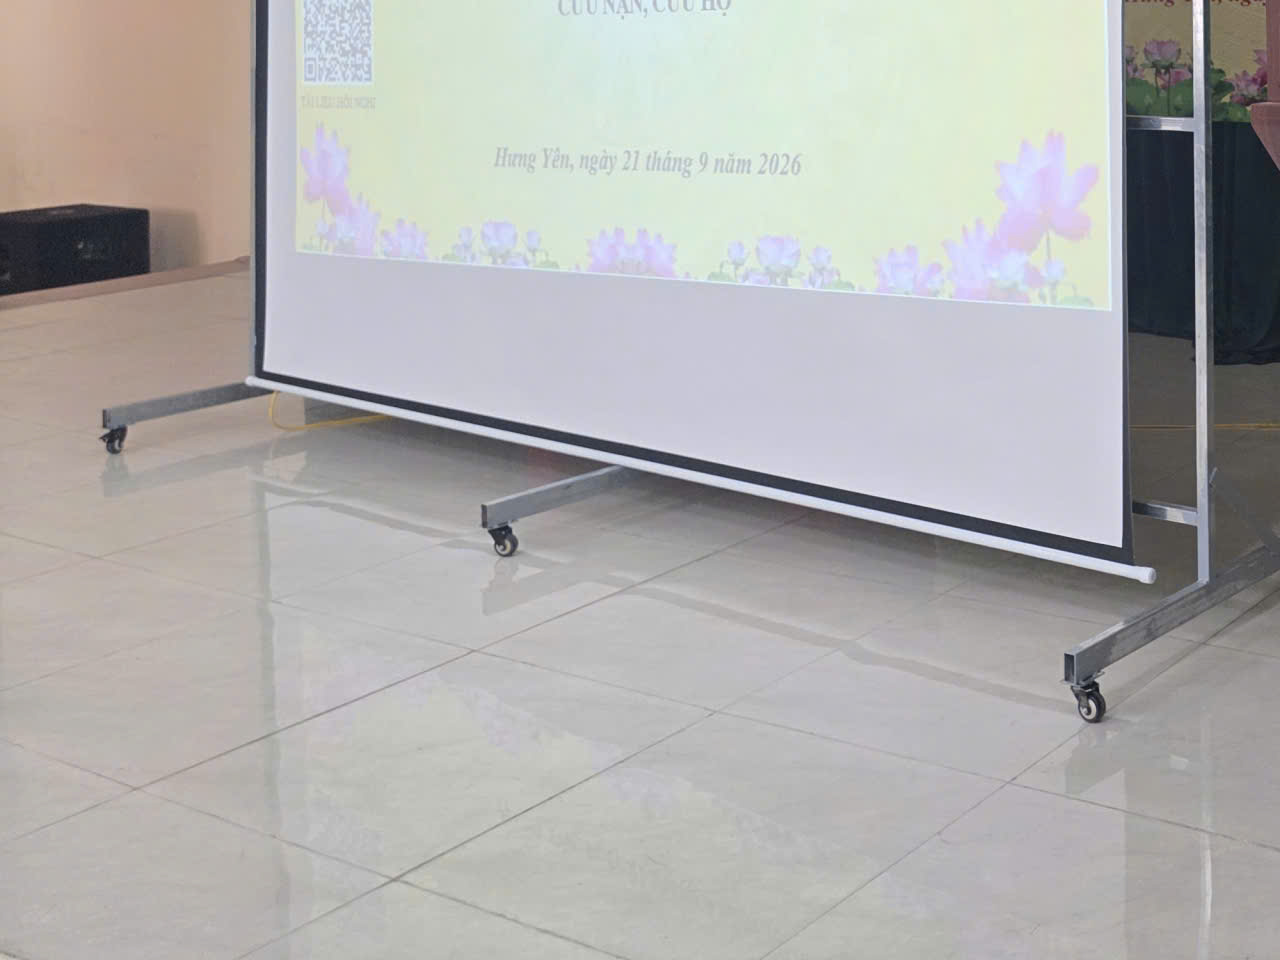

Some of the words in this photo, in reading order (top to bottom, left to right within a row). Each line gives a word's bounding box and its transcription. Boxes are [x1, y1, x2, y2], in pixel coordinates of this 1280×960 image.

[494, 147, 536, 173] Hưng
[541, 147, 575, 174] Yên,
[579, 150, 617, 176] ngày
[621, 150, 640, 172] 21
[645, 150, 694, 178] tháng
[699, 152, 709, 173] 9
[713, 152, 752, 175] năm
[757, 152, 802, 176] 2026
